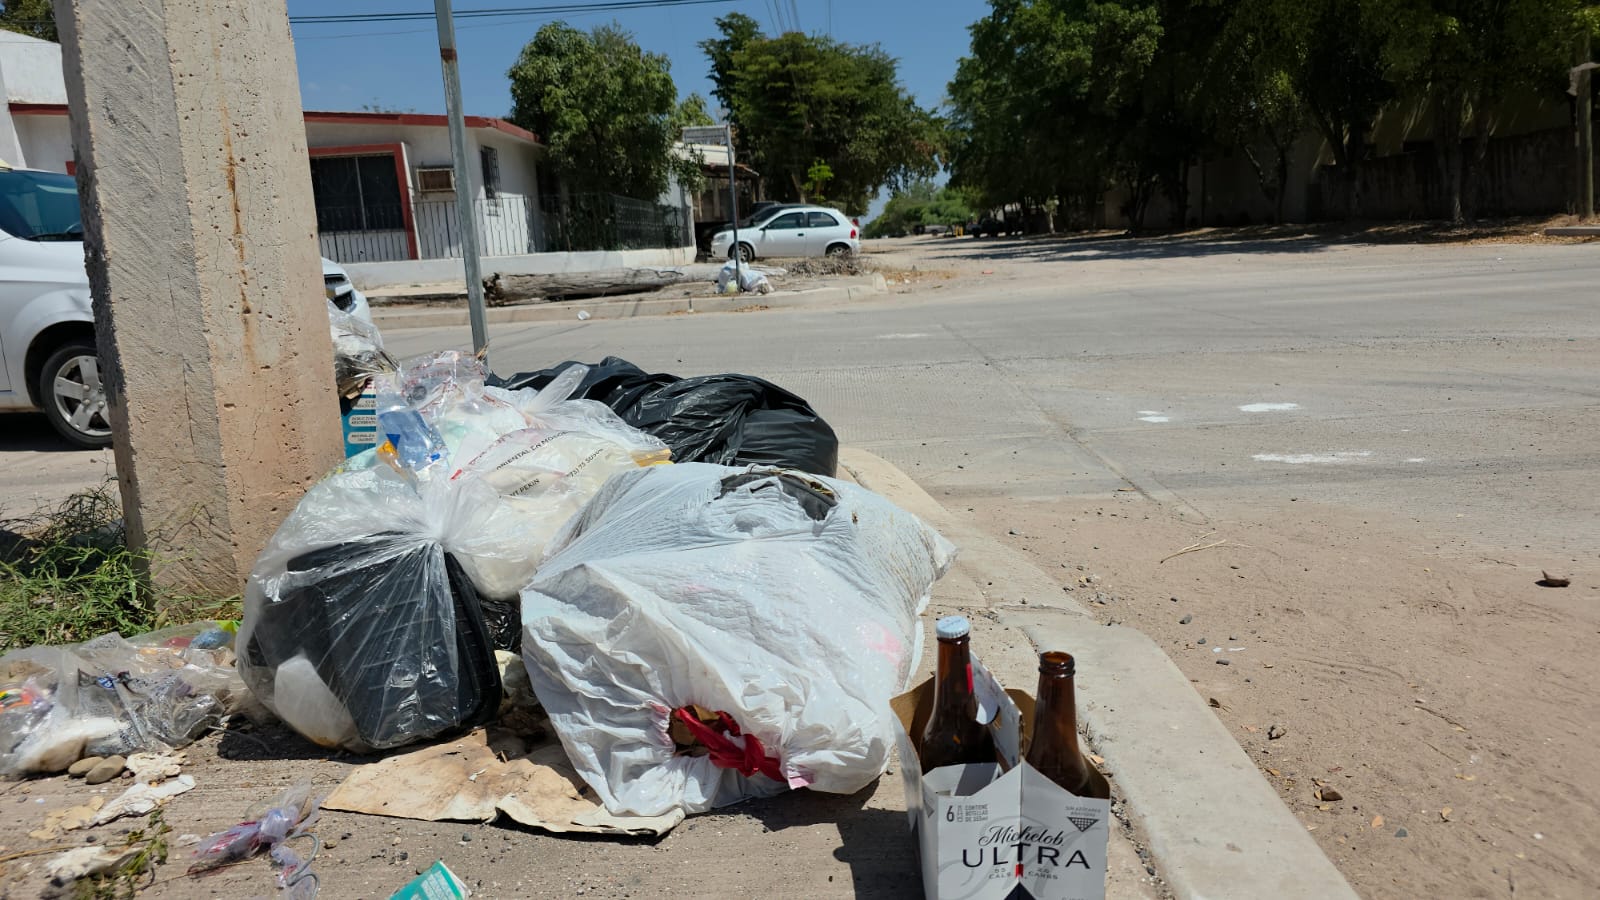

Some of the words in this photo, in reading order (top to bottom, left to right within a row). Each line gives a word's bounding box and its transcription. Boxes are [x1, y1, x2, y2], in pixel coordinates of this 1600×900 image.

[519, 478, 540, 492] PEKIN
[946, 804, 955, 823] 6
[978, 825, 1064, 846] Michelob
[962, 843, 1091, 870] ULTRA
